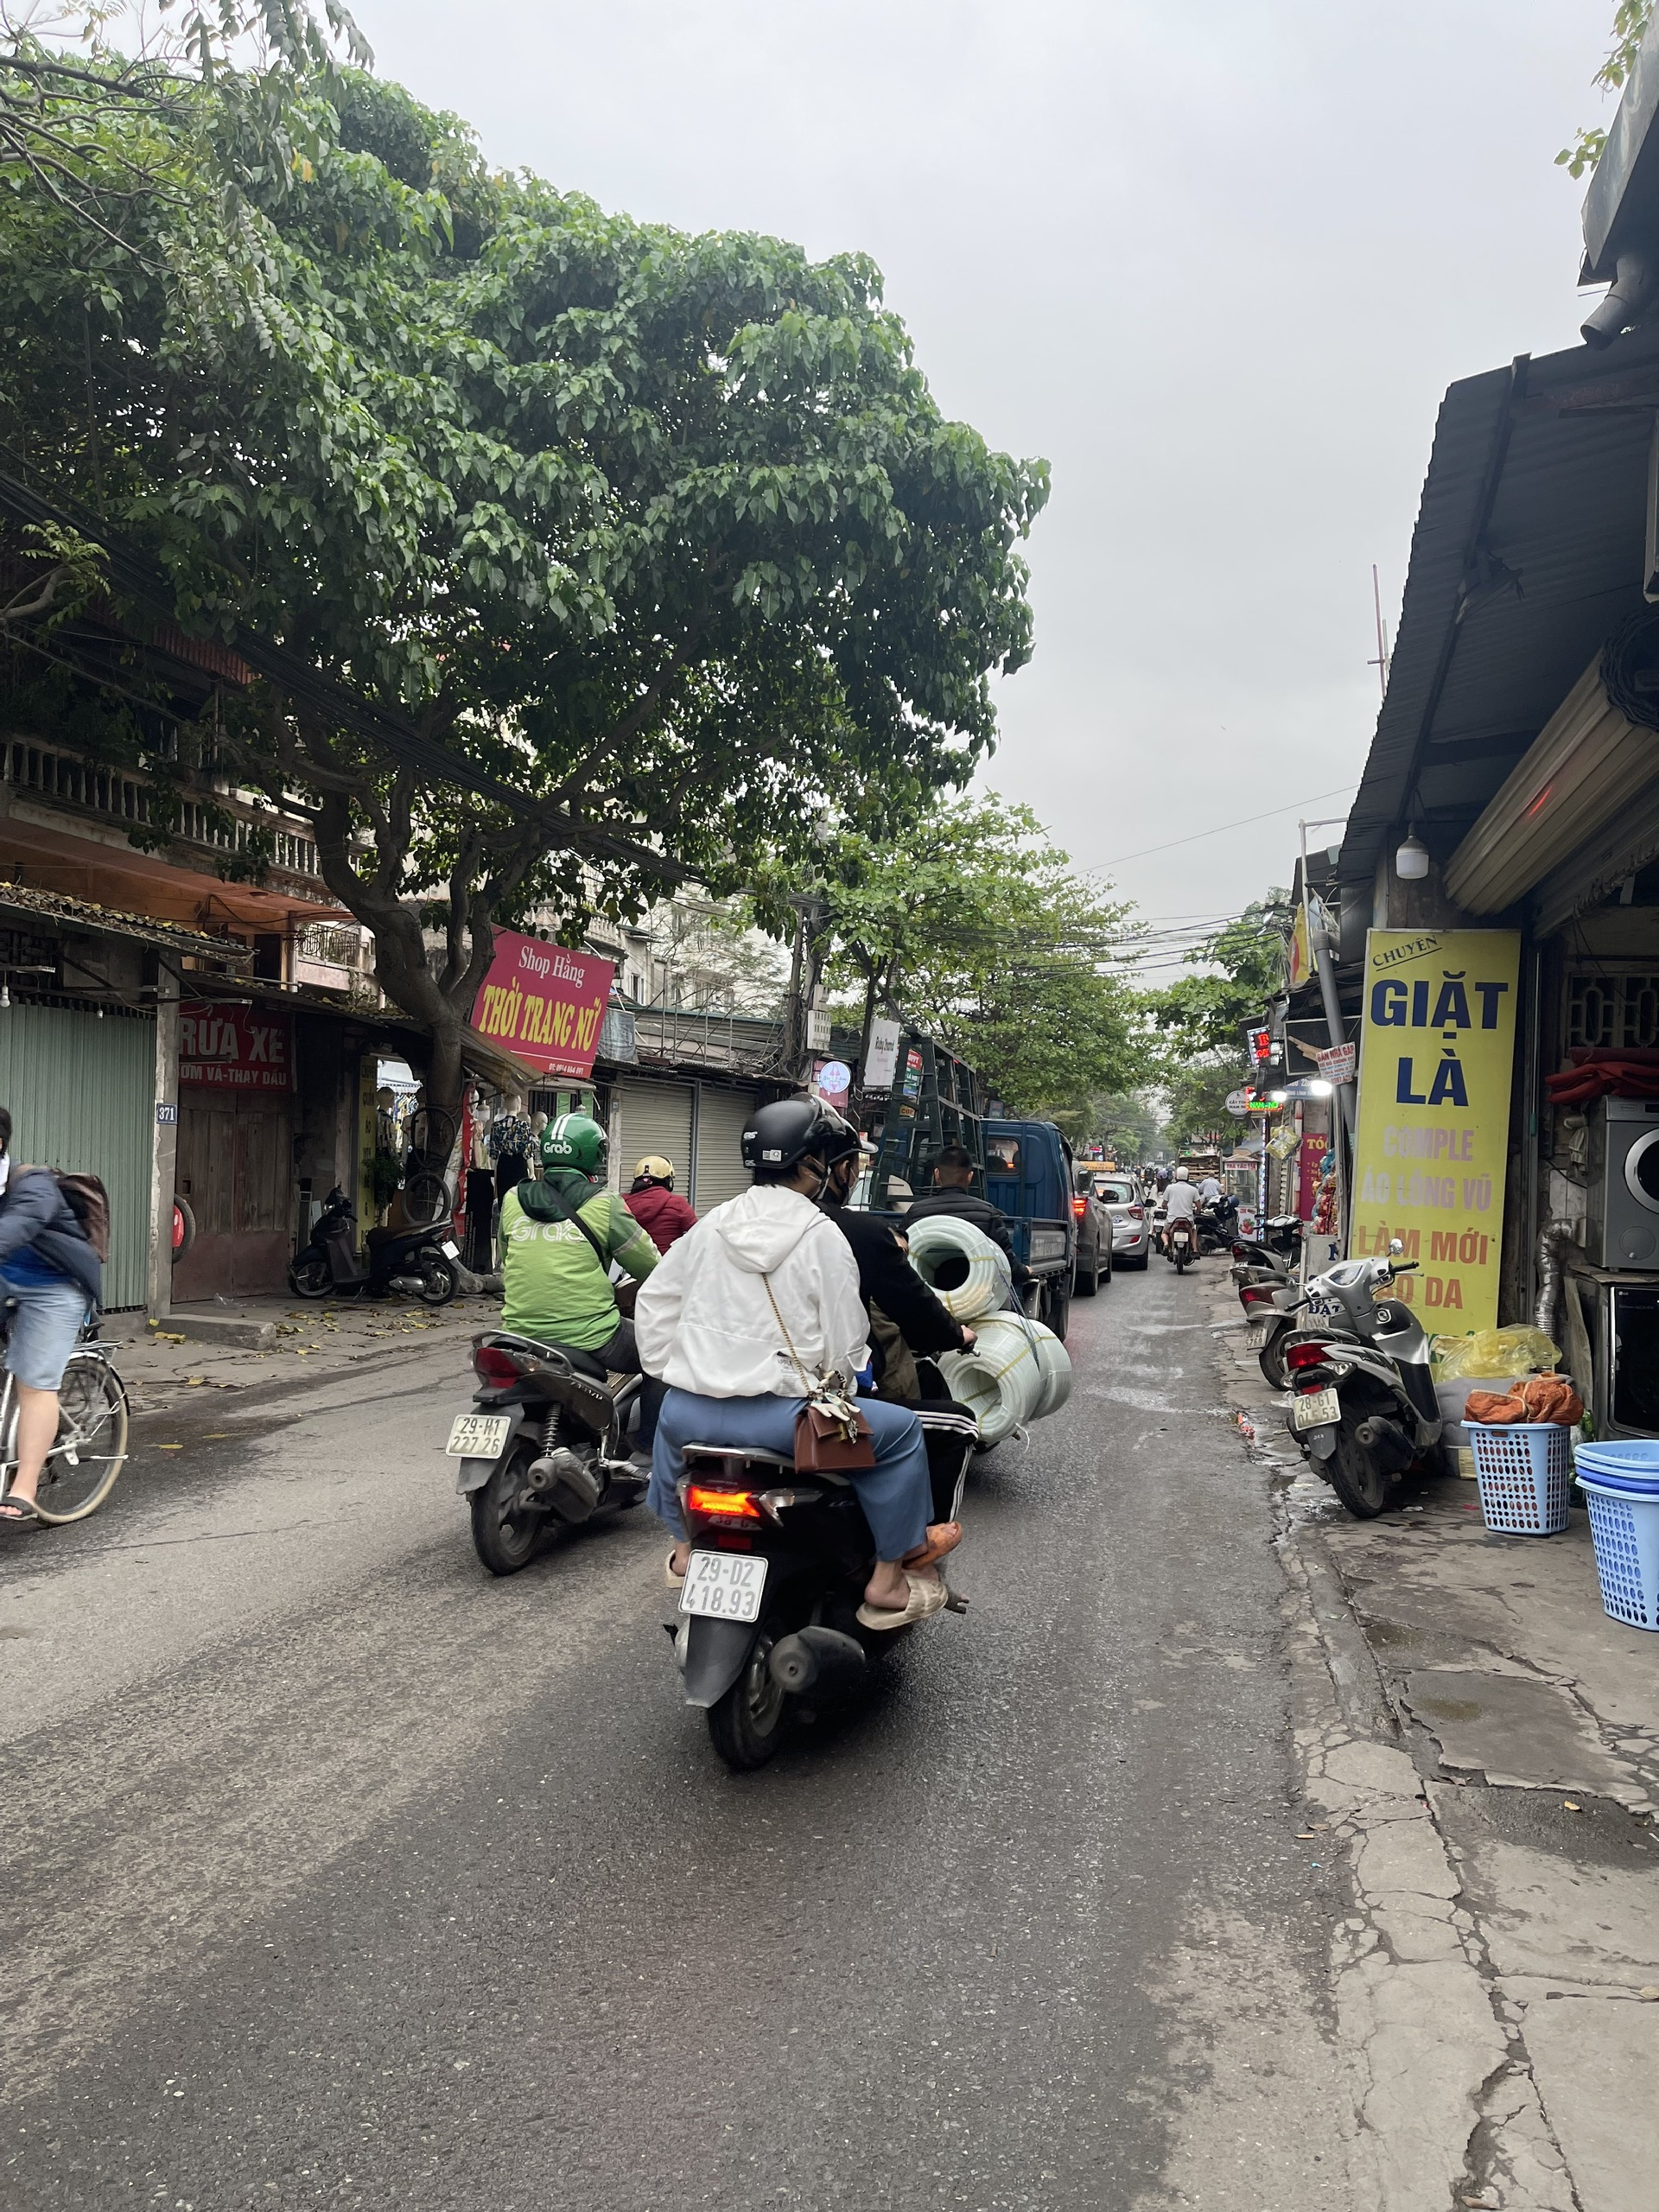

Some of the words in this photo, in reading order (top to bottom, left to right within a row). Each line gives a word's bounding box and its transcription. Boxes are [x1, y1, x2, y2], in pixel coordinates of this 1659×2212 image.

[518, 945, 550, 979] Shop
[552, 953, 585, 988] Hằng
[1372, 935, 1439, 967] CHUYÊN
[479, 976, 523, 1038] THỜI
[520, 995, 575, 1047] TRANG
[571, 996, 601, 1052] NỮ
[1370, 970, 1509, 1039] GIẶT
[179, 1004, 239, 1060] RỬA
[249, 1026, 285, 1064] XE
[1396, 1048, 1469, 1107] LÀ
[159, 1107, 175, 1121] 371
[543, 1141, 572, 1154] Grab
[1384, 1125, 1474, 1161] COMPLE
[1361, 1165, 1390, 1204] ÁO
[1396, 1166, 1455, 1209] LÔNG
[1463, 1173, 1492, 1211] VŨ
[512, 1216, 586, 1243] Grab
[1358, 1220, 1421, 1260] LÀM
[1431, 1227, 1488, 1265] MỚI
[1426, 1276, 1464, 1310] DA
[1299, 1392, 1330, 1412] 28-G1
[460, 1417, 501, 1435] 29-H1
[697, 1556, 755, 1587] 29-D2
[685, 1583, 756, 1617] 418.93
